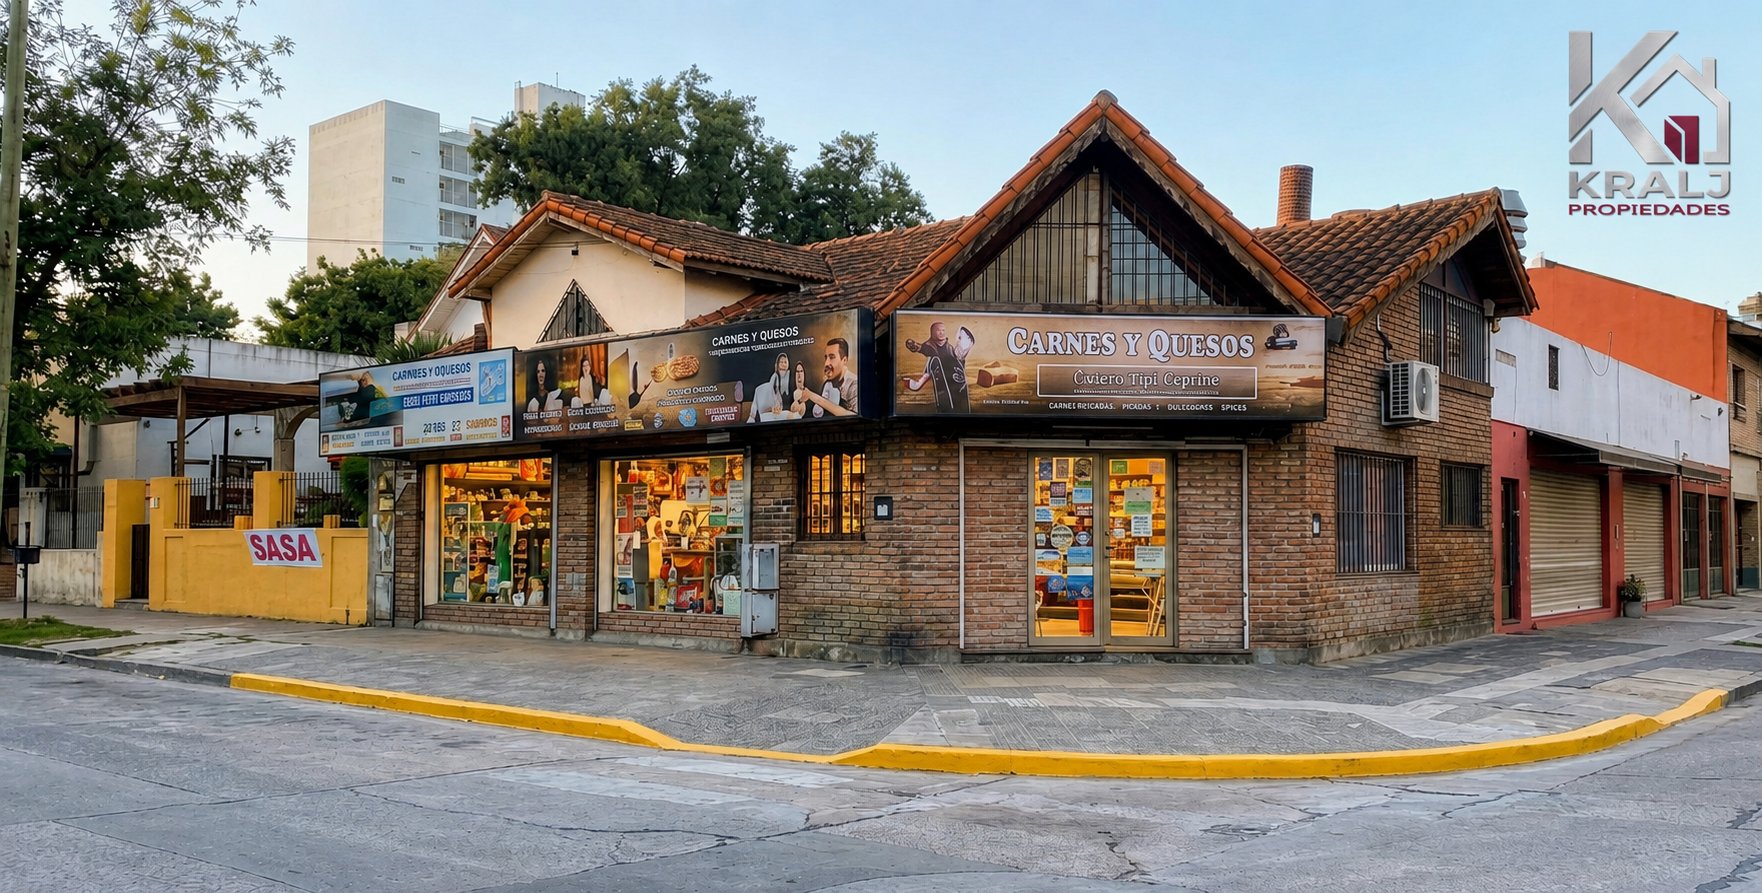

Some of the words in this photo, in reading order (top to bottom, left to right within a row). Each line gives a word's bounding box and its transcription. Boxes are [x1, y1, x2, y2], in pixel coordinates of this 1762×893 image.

[712, 333, 749, 347] CARNES
[751, 331, 758, 342] Y
[760, 326, 799, 341] QUESOS
[1007, 327, 1116, 356] CARNES
[1122, 332, 1142, 356] Y
[1147, 329, 1255, 363] QUESOS
[428, 366, 433, 377] Y
[1128, 372, 1158, 389] Tipi
[1163, 371, 1219, 389] Ceprine
[1221, 404, 1247, 412] SPICES
[250, 534, 316, 562] SASA
